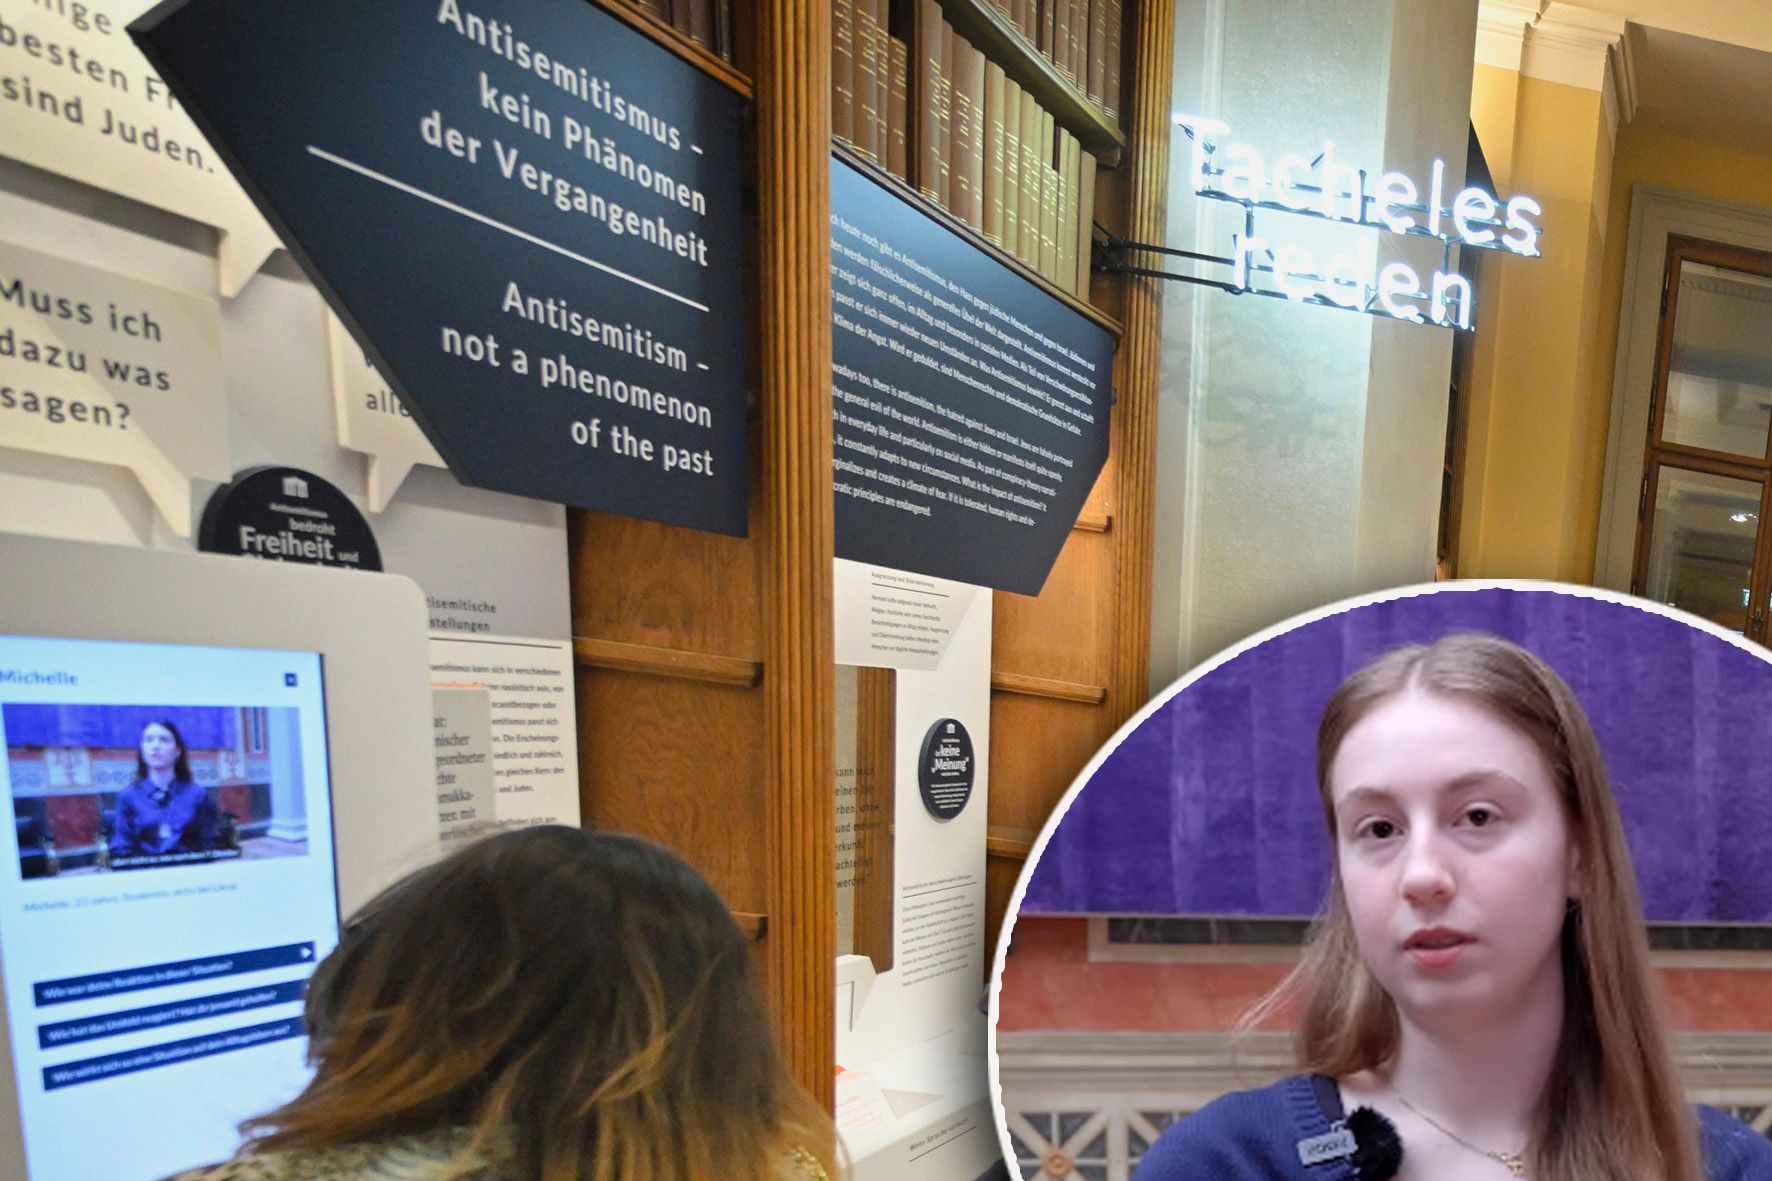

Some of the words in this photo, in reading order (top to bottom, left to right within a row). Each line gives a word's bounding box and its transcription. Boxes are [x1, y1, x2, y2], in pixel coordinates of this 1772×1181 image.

[0, 13, 128, 92] besten
[437, 0, 682, 152] Antisemitismus
[2, 77, 84, 125] sind
[99, 108, 215, 174] Juden.
[479, 71, 552, 139] kein
[563, 116, 706, 216] Phänomen
[420, 109, 482, 164] der
[493, 139, 708, 267] Vergangenheit
[1172, 112, 1542, 256] Tacheles
[0, 278, 94, 325] Muss
[108, 303, 162, 342] ich
[1232, 233, 1473, 330] reden
[0, 328, 87, 373] dazu
[102, 357, 170, 391] was
[502, 281, 687, 372] Antisemitism
[0, 386, 130, 429] sagen?
[442, 326, 500, 367] not
[511, 349, 529, 375] a
[540, 354, 712, 428] phenomenon
[832, 384, 842, 398] the
[571, 418, 601, 448] of
[610, 426, 654, 461] the
[663, 444, 714, 476] past
[837, 434, 843, 446] it
[239, 524, 335, 561] Freiheit
[337, 551, 360, 563] und
[287, 517, 336, 537] bedroht
